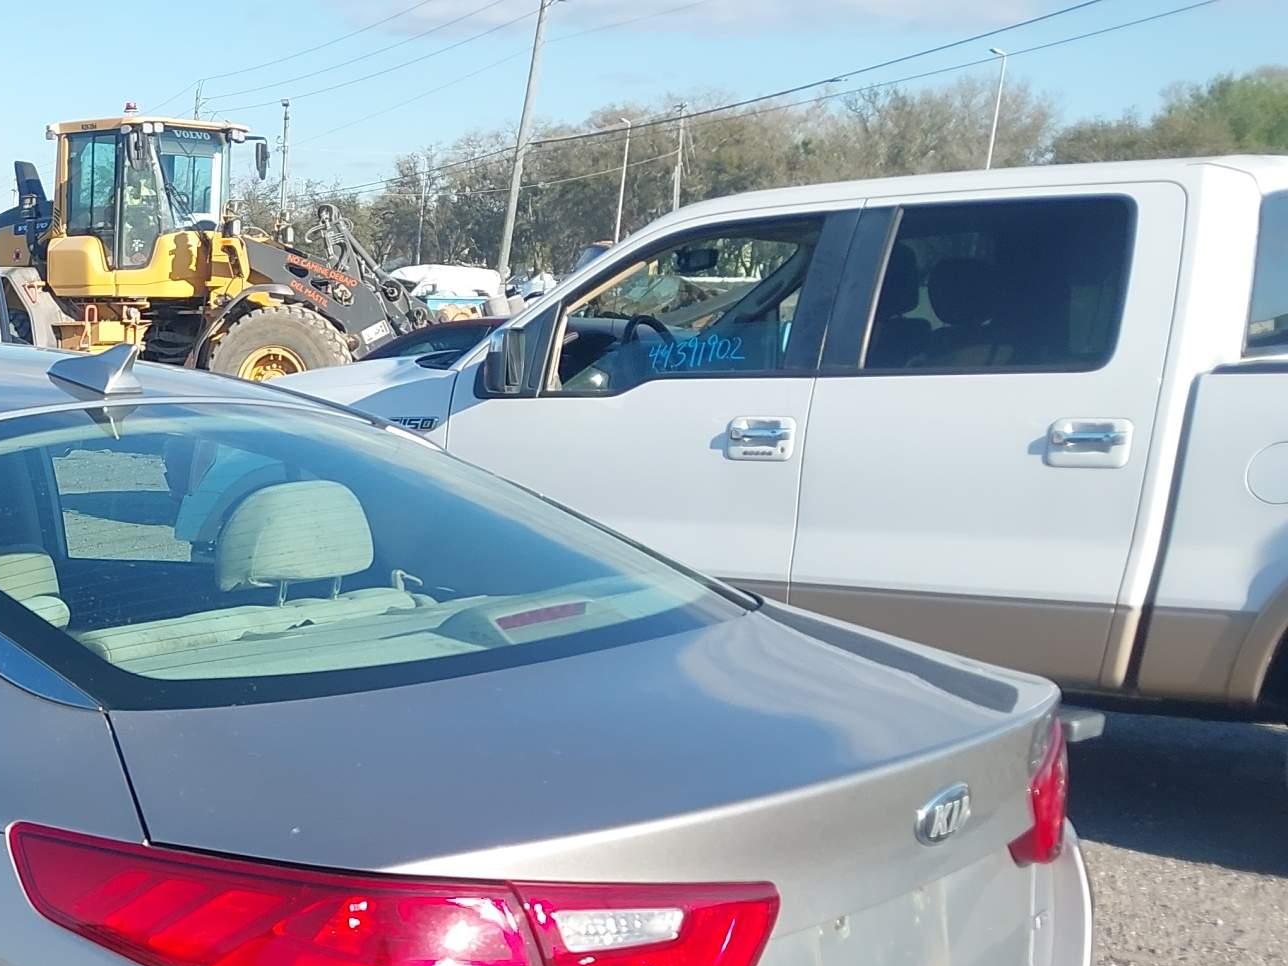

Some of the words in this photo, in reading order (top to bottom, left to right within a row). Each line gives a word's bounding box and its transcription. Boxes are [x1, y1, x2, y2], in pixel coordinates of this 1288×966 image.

[173, 129, 211, 140] VOLVO
[287, 254, 300, 264] NO
[301, 259, 330, 276] CAMINE
[330, 271, 358, 287] DEBAJO
[291, 280, 304, 293] DEL
[648, 335, 745, 368] 44391902
